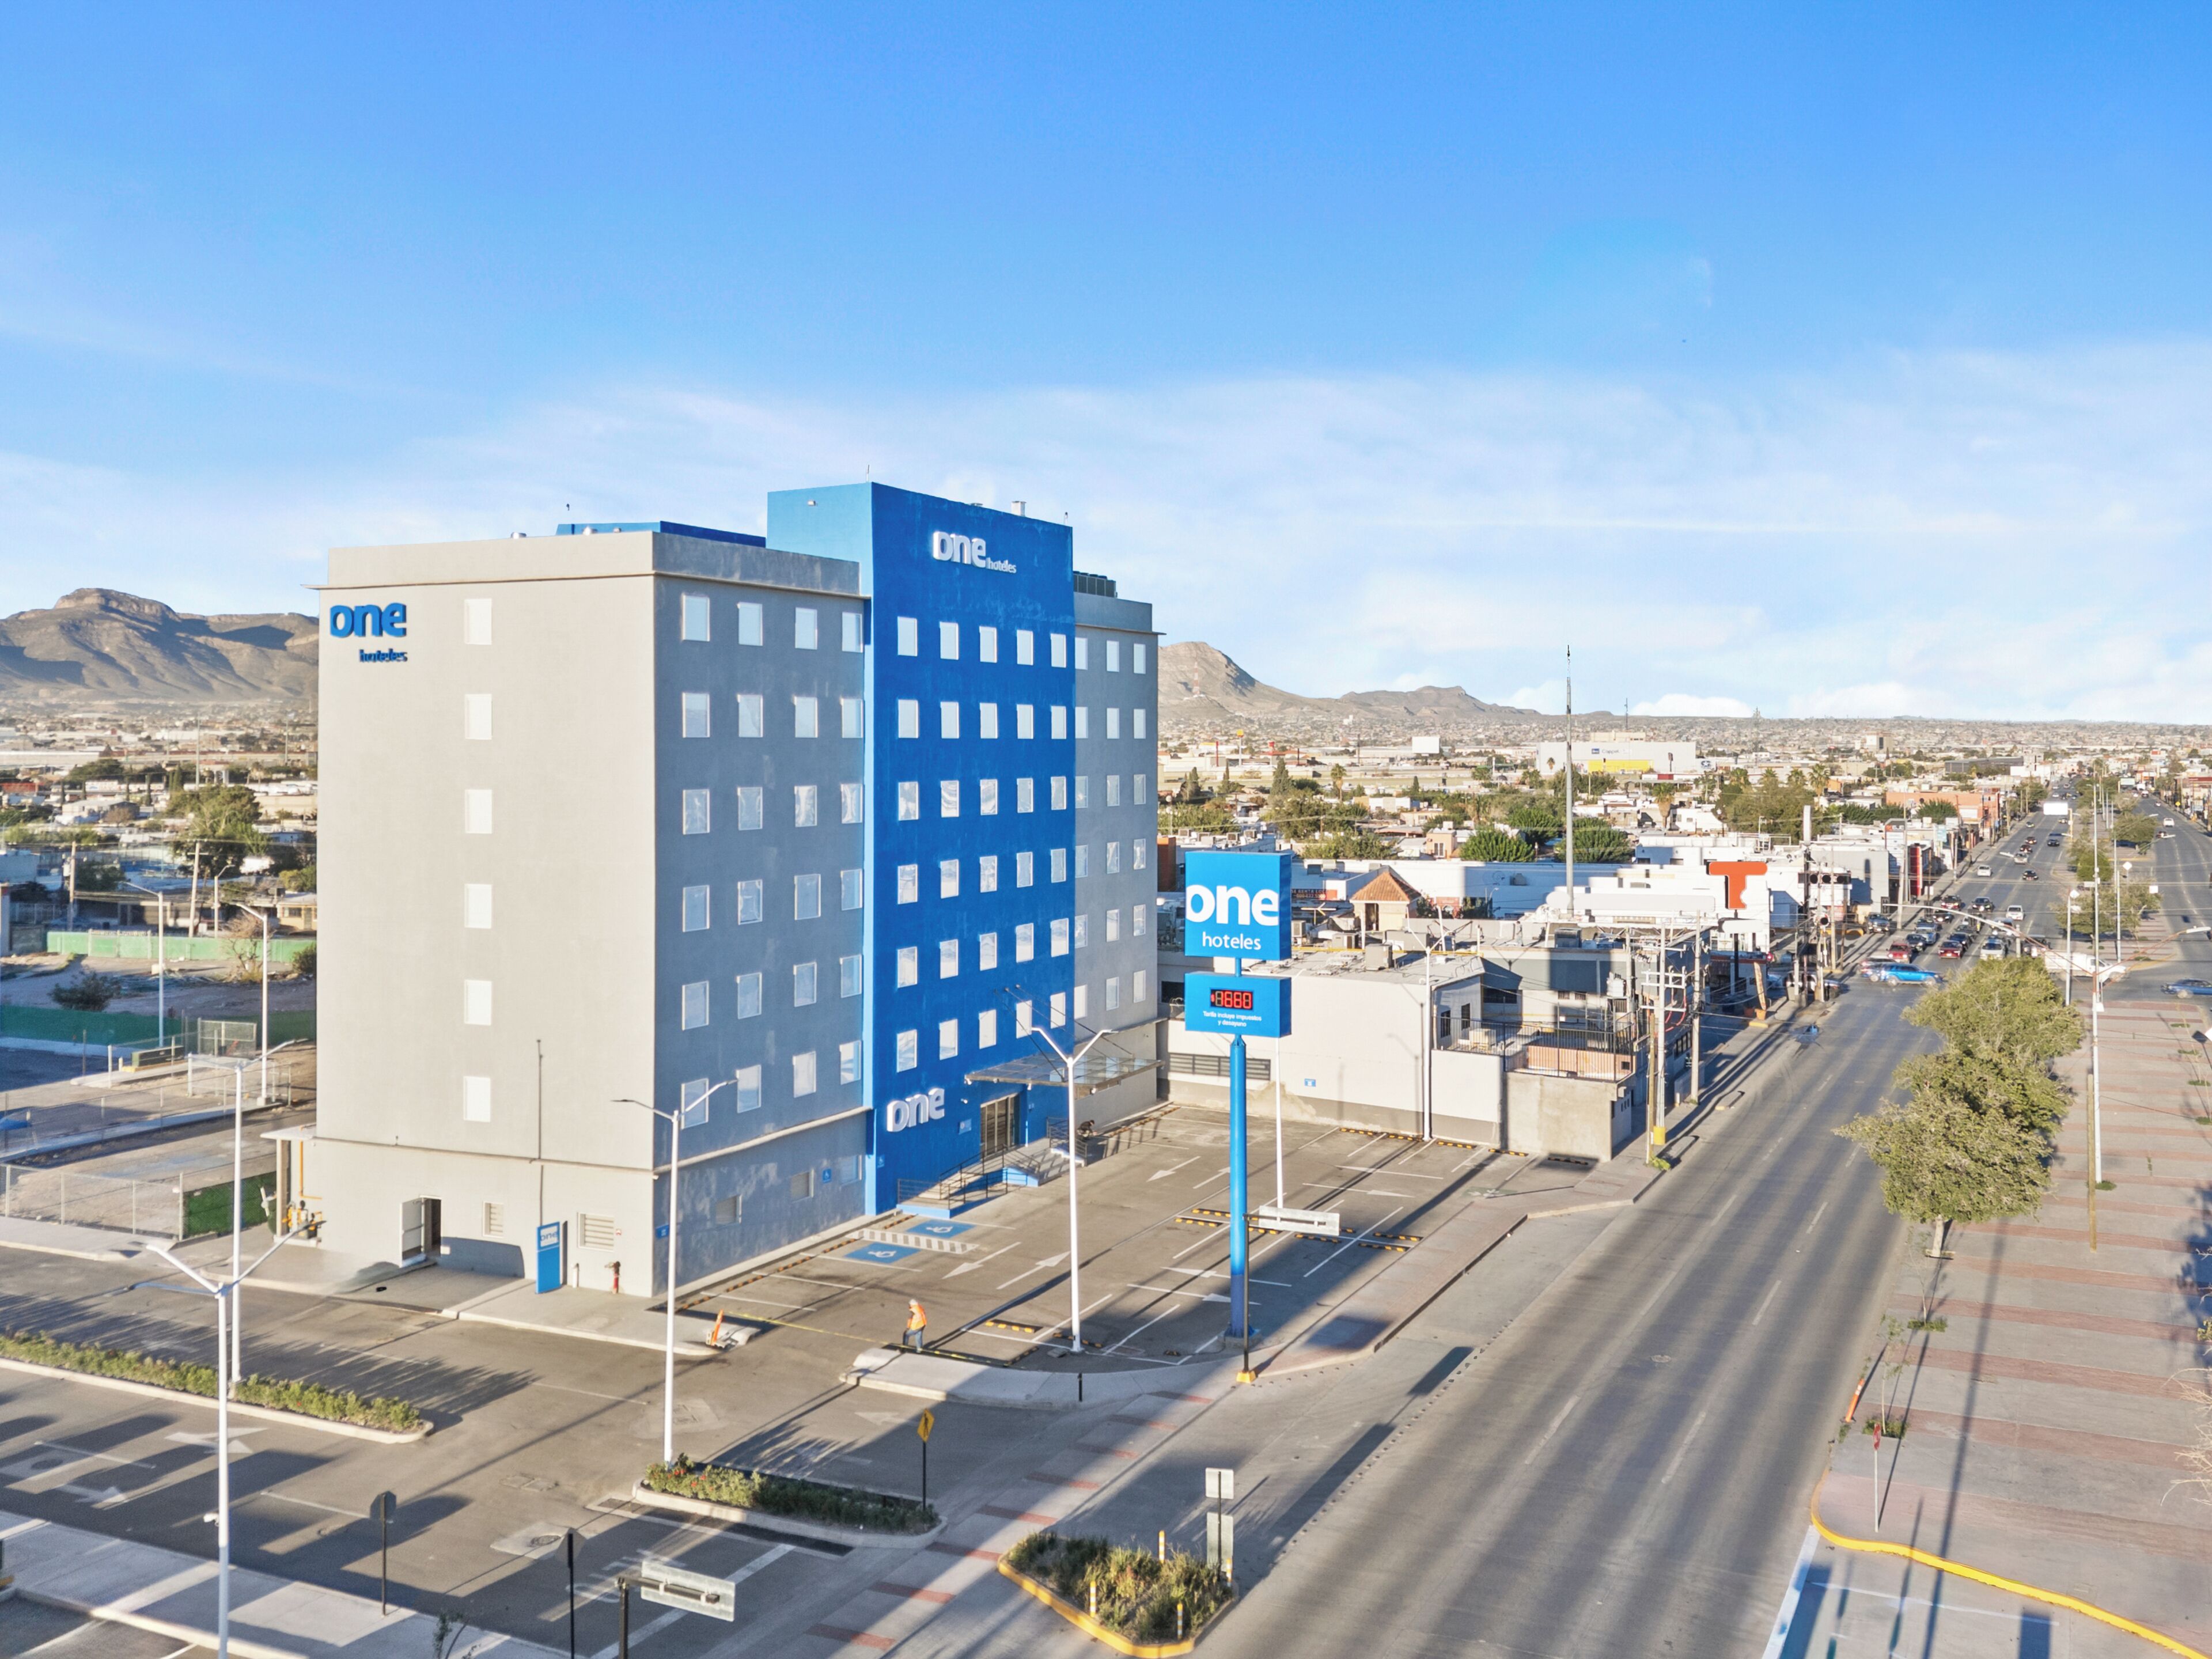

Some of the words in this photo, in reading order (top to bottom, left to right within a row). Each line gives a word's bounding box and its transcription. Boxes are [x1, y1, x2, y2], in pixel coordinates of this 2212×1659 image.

[932, 531, 987, 568] one
[986, 557, 1017, 574] hoteles
[329, 603, 407, 638] one
[359, 648, 408, 662] hoteles
[1185, 884, 1279, 926] one
[1202, 931, 1262, 950] hoteles
[887, 1087, 945, 1132] one
[540, 1231, 559, 1241] one
